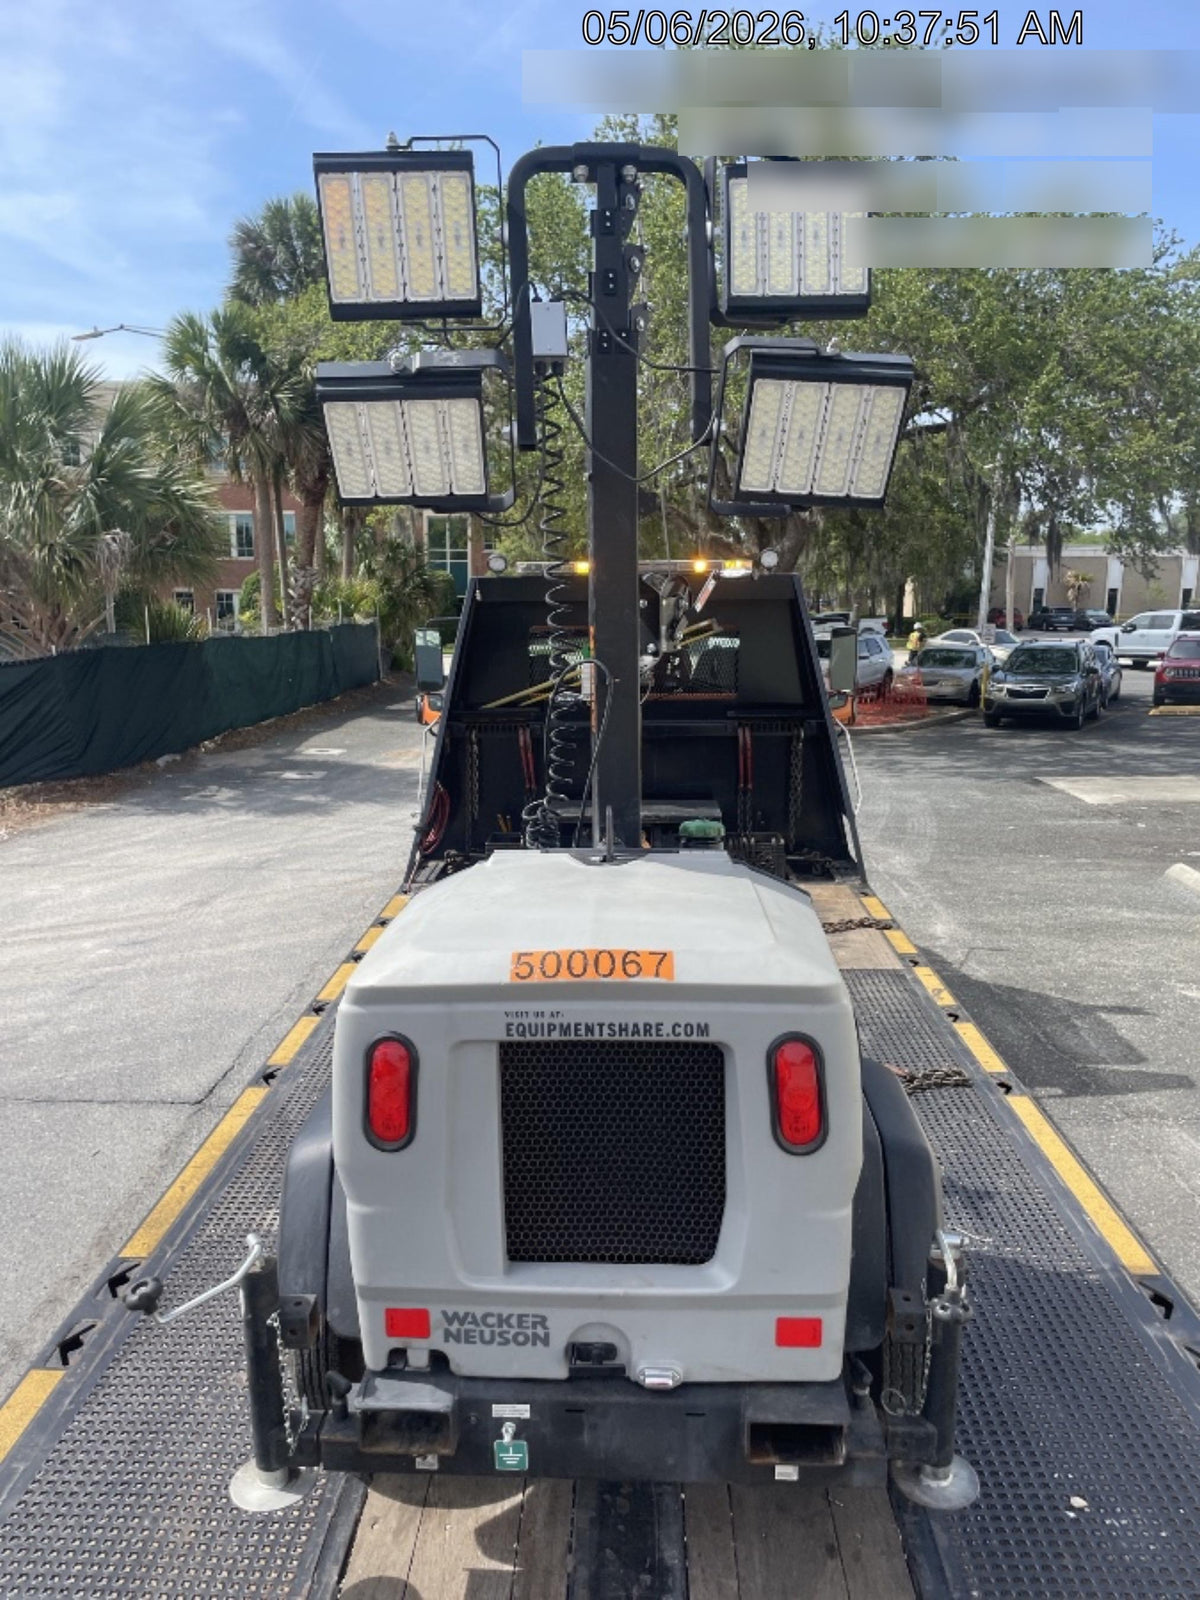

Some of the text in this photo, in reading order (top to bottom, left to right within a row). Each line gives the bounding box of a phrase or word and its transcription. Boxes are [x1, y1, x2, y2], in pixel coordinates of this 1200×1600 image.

[514, 950, 668, 980] 500067
[505, 1022, 710, 1038] EQUIPMENTSHARE.COM
[441, 1310, 550, 1330] WACKER
[443, 1328, 550, 1347] NEUSON
